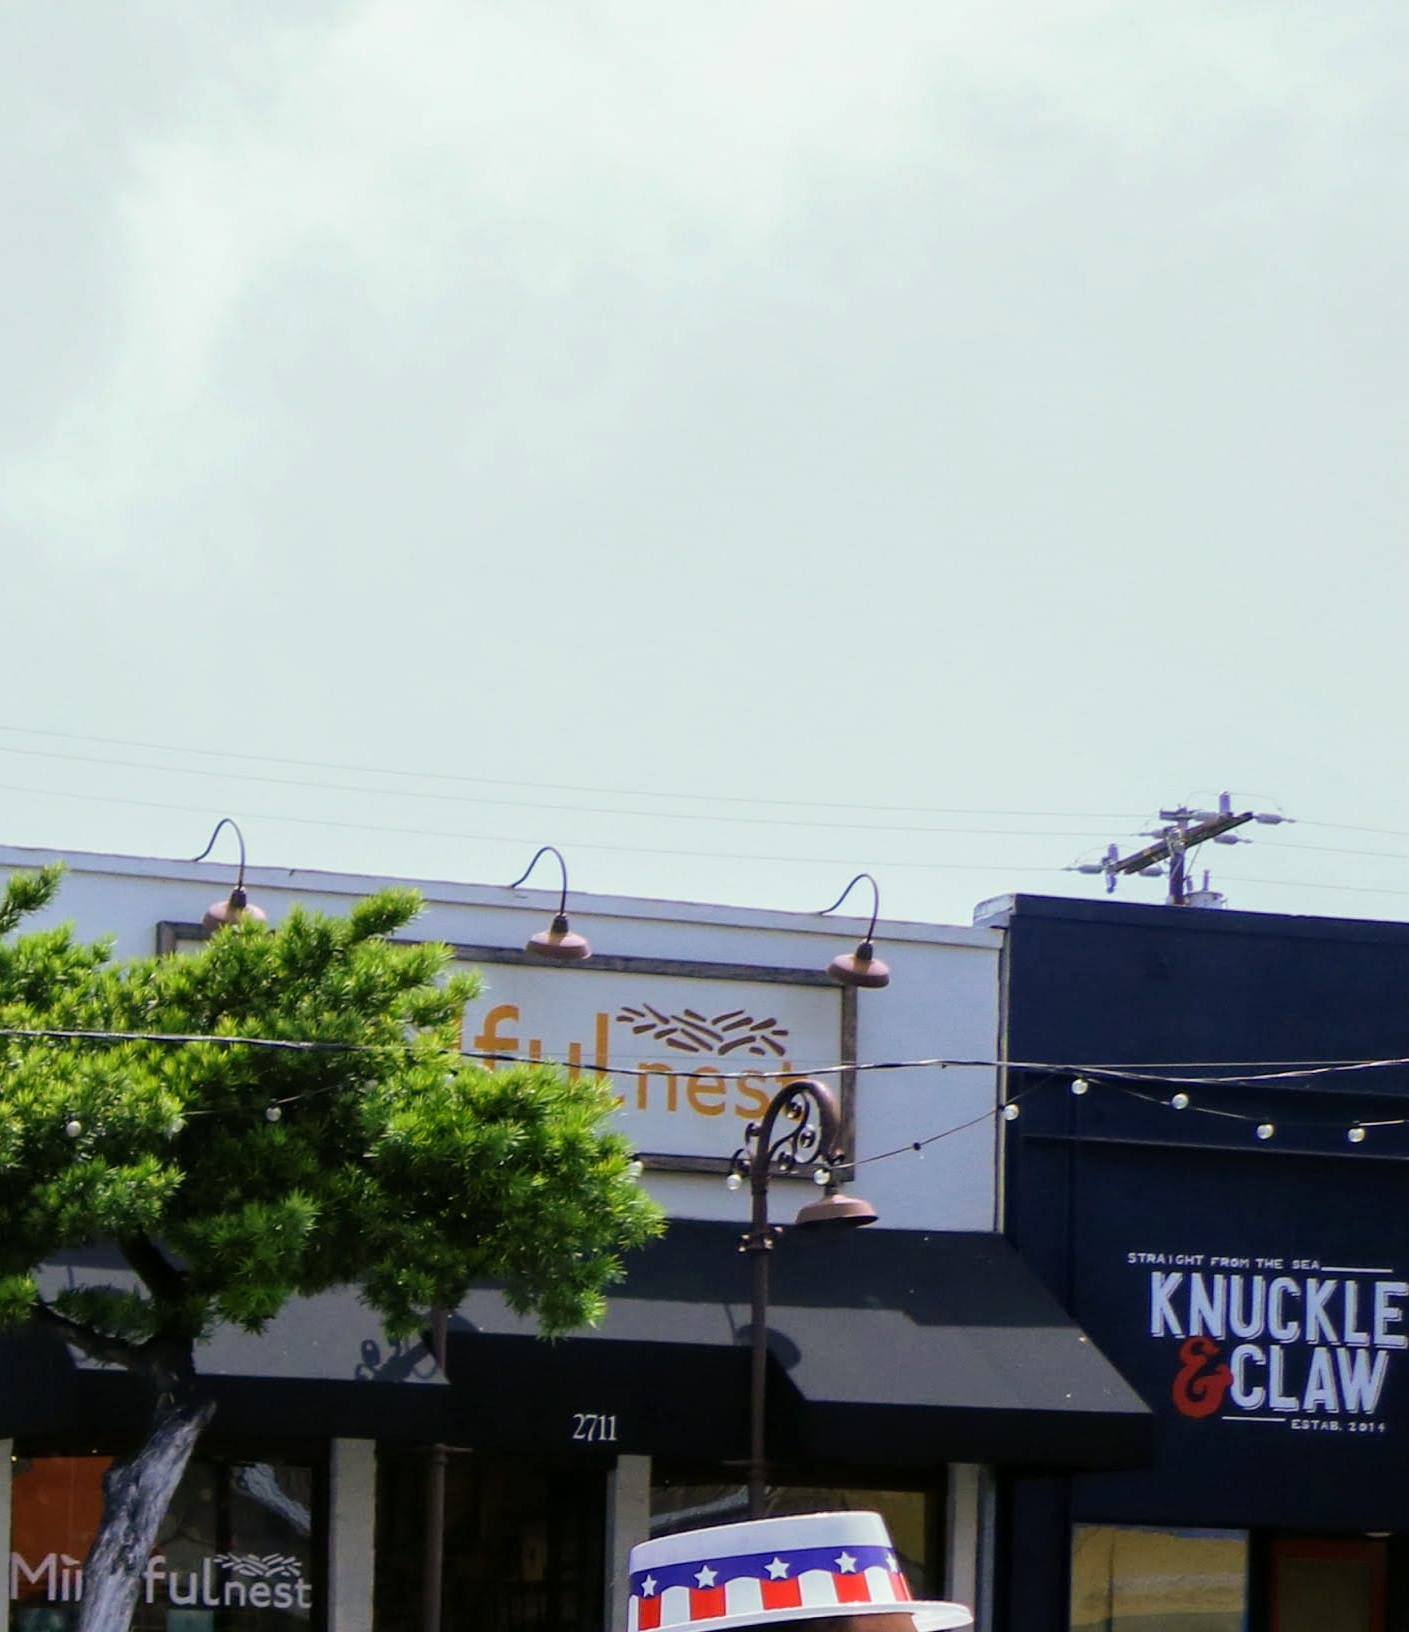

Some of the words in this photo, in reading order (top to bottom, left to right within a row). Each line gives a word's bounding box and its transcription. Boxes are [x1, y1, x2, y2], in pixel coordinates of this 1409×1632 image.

[1127, 1252, 1205, 1266] STRAIGHT
[1210, 1257, 1250, 1269] FROM
[1255, 1258, 1284, 1269] THE
[1292, 1260, 1320, 1270] SEA
[1150, 1270, 1409, 1349] KNUCKLE
[1172, 1336, 1234, 1418] &
[1229, 1344, 1390, 1415] CLAW
[572, 1413, 618, 1442] 2711
[1291, 1419, 1342, 1431] ESTAB.
